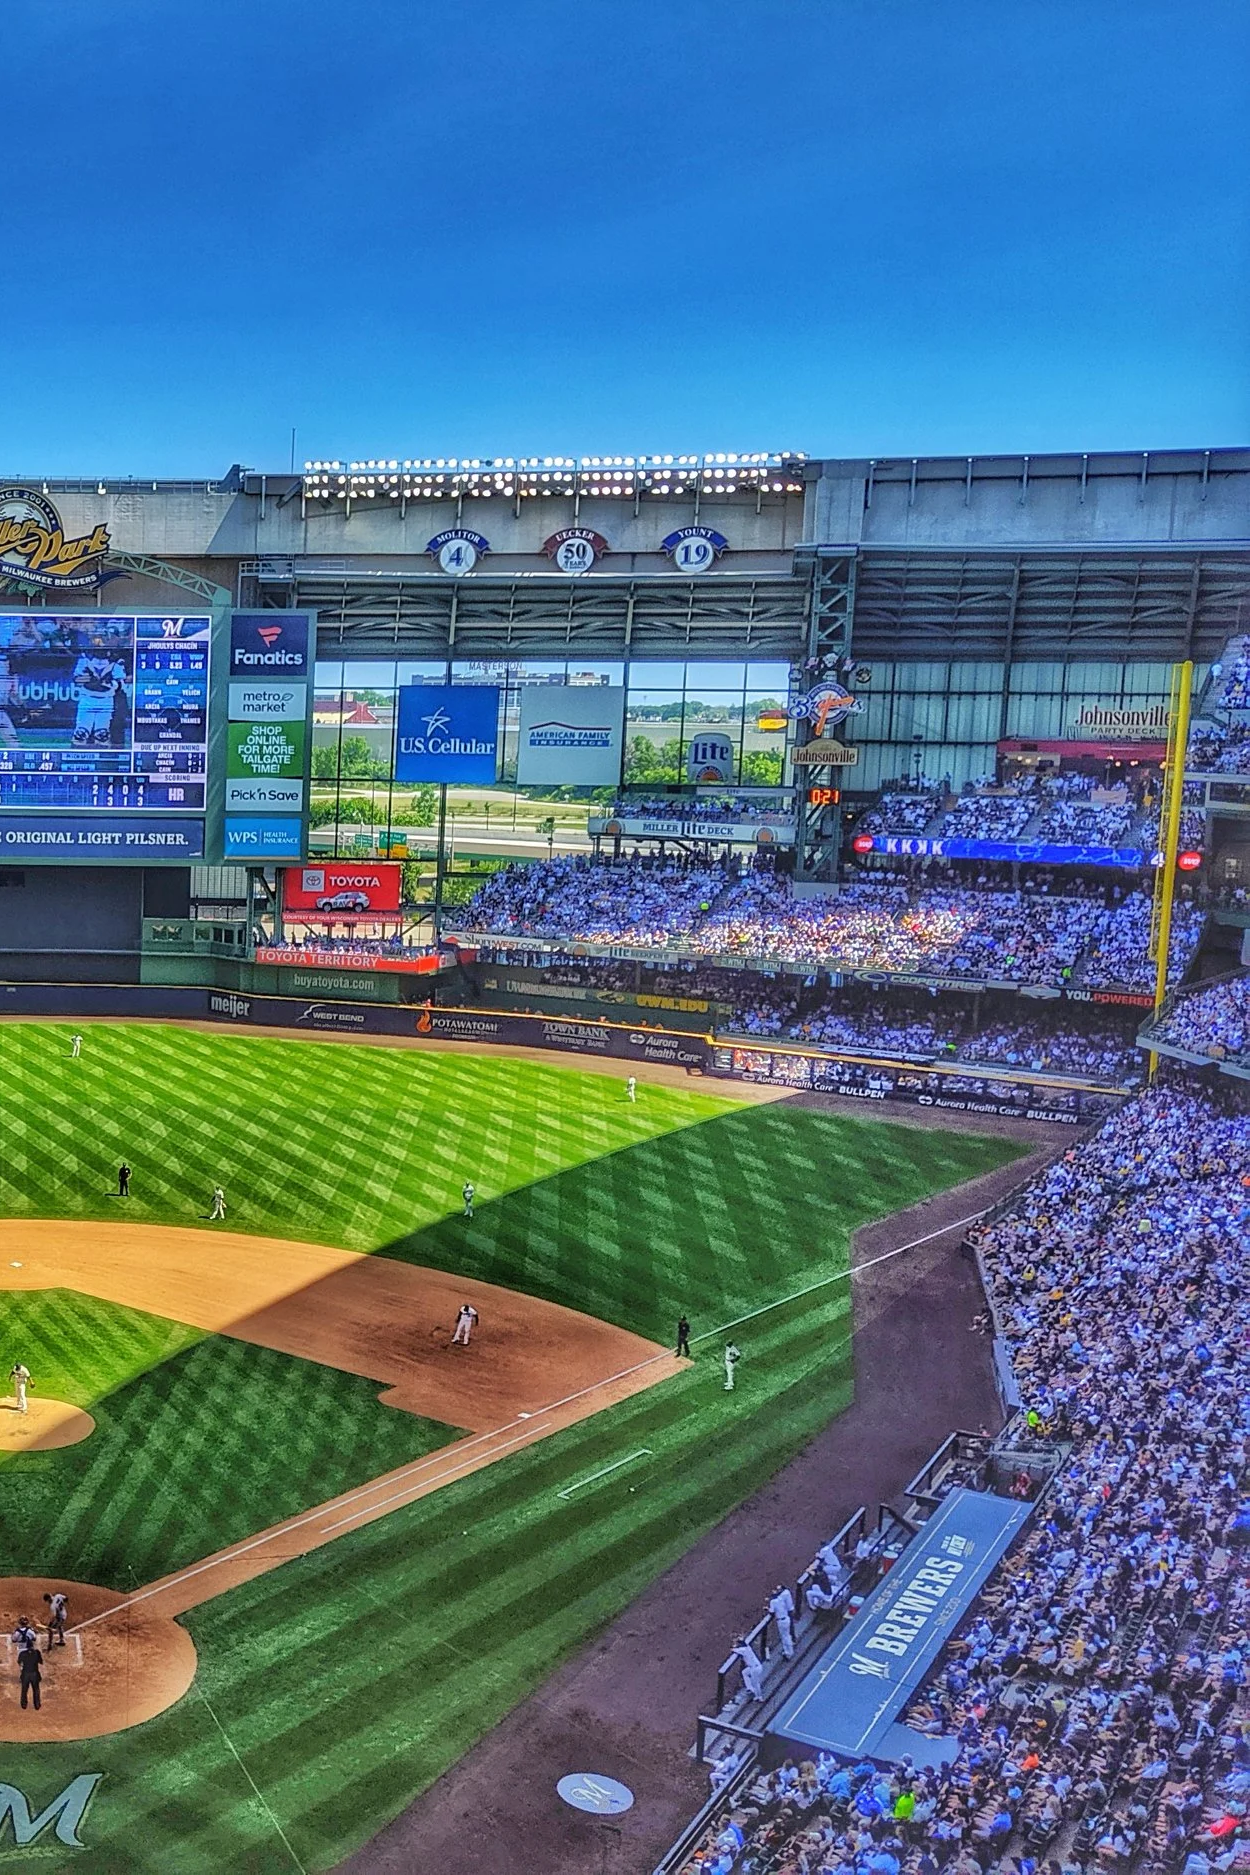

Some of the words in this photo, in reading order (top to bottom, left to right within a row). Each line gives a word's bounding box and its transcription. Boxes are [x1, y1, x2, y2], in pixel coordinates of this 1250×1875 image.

[23, 493, 46, 508] 2001
[436, 531, 481, 545] MOLITOR
[556, 531, 594, 542] UECKER
[677, 528, 714, 538] YOUNT
[16, 524, 110, 570] Park
[563, 543, 586, 560] 50
[448, 546, 463, 566] 4
[681, 544, 708, 566] 19
[2, 566, 52, 585] MILWAUKEE
[54, 575, 97, 586] BREWERS
[234, 649, 303, 665] Fanatics
[243, 691, 280, 702] metro
[243, 701, 286, 713] market
[1075, 705, 1171, 726] Johnsonville
[252, 726, 282, 736] SHOP
[530, 732, 576, 740] AMERICAN
[578, 732, 610, 740] FAMILY
[246, 736, 286, 745] ONLINE
[400, 738, 426, 754] U.S.
[429, 738, 495, 754] Cellular
[238, 745, 261, 754] FOR
[262, 745, 294, 754] MORE
[693, 742, 729, 764] Lite
[794, 748, 855, 763] Johnsonville
[241, 755, 290, 764] TAILGATE
[251, 764, 280, 774] TIME!
[168, 788, 184, 801] HR
[230, 790, 256, 800] Pick
[268, 790, 299, 801] Save
[6, 832, 74, 844] ORIGINAL
[78, 833, 118, 845] LIGHT
[125, 833, 189, 846] PILSNER.
[228, 832, 258, 843] WPS
[886, 838, 898, 852] K
[901, 839, 912, 854] K
[932, 840, 944, 855] K
[329, 876, 380, 888] TOYOTA
[259, 950, 308, 963] TOYOTA
[310, 954, 379, 968] TERRITORY
[294, 973, 374, 991] buyatoyota.com
[210, 995, 250, 1018] meijer
[636, 994, 709, 1012] UWM.EDU
[312, 1012, 338, 1020] WEST
[338, 1014, 364, 1022] BEND
[432, 1018, 498, 1032] POTAWATOMI
[542, 1022, 576, 1034] TOWN
[578, 1026, 609, 1040] BANK
[646, 1036, 679, 1048] Aurora
[644, 1047, 676, 1059] Health
[677, 1052, 700, 1062] Care
[756, 1074, 784, 1086] Aurora
[785, 1078, 813, 1090] Health
[814, 1082, 834, 1092] Care
[838, 1086, 886, 1100] BULLPEN
[934, 1098, 965, 1110] Aurora
[966, 1102, 998, 1114] Health
[999, 1106, 1020, 1116] Care
[1026, 1110, 1078, 1124] BULLPEN
[864, 1556, 965, 1658] BREWERS
[849, 1652, 890, 1679] M
